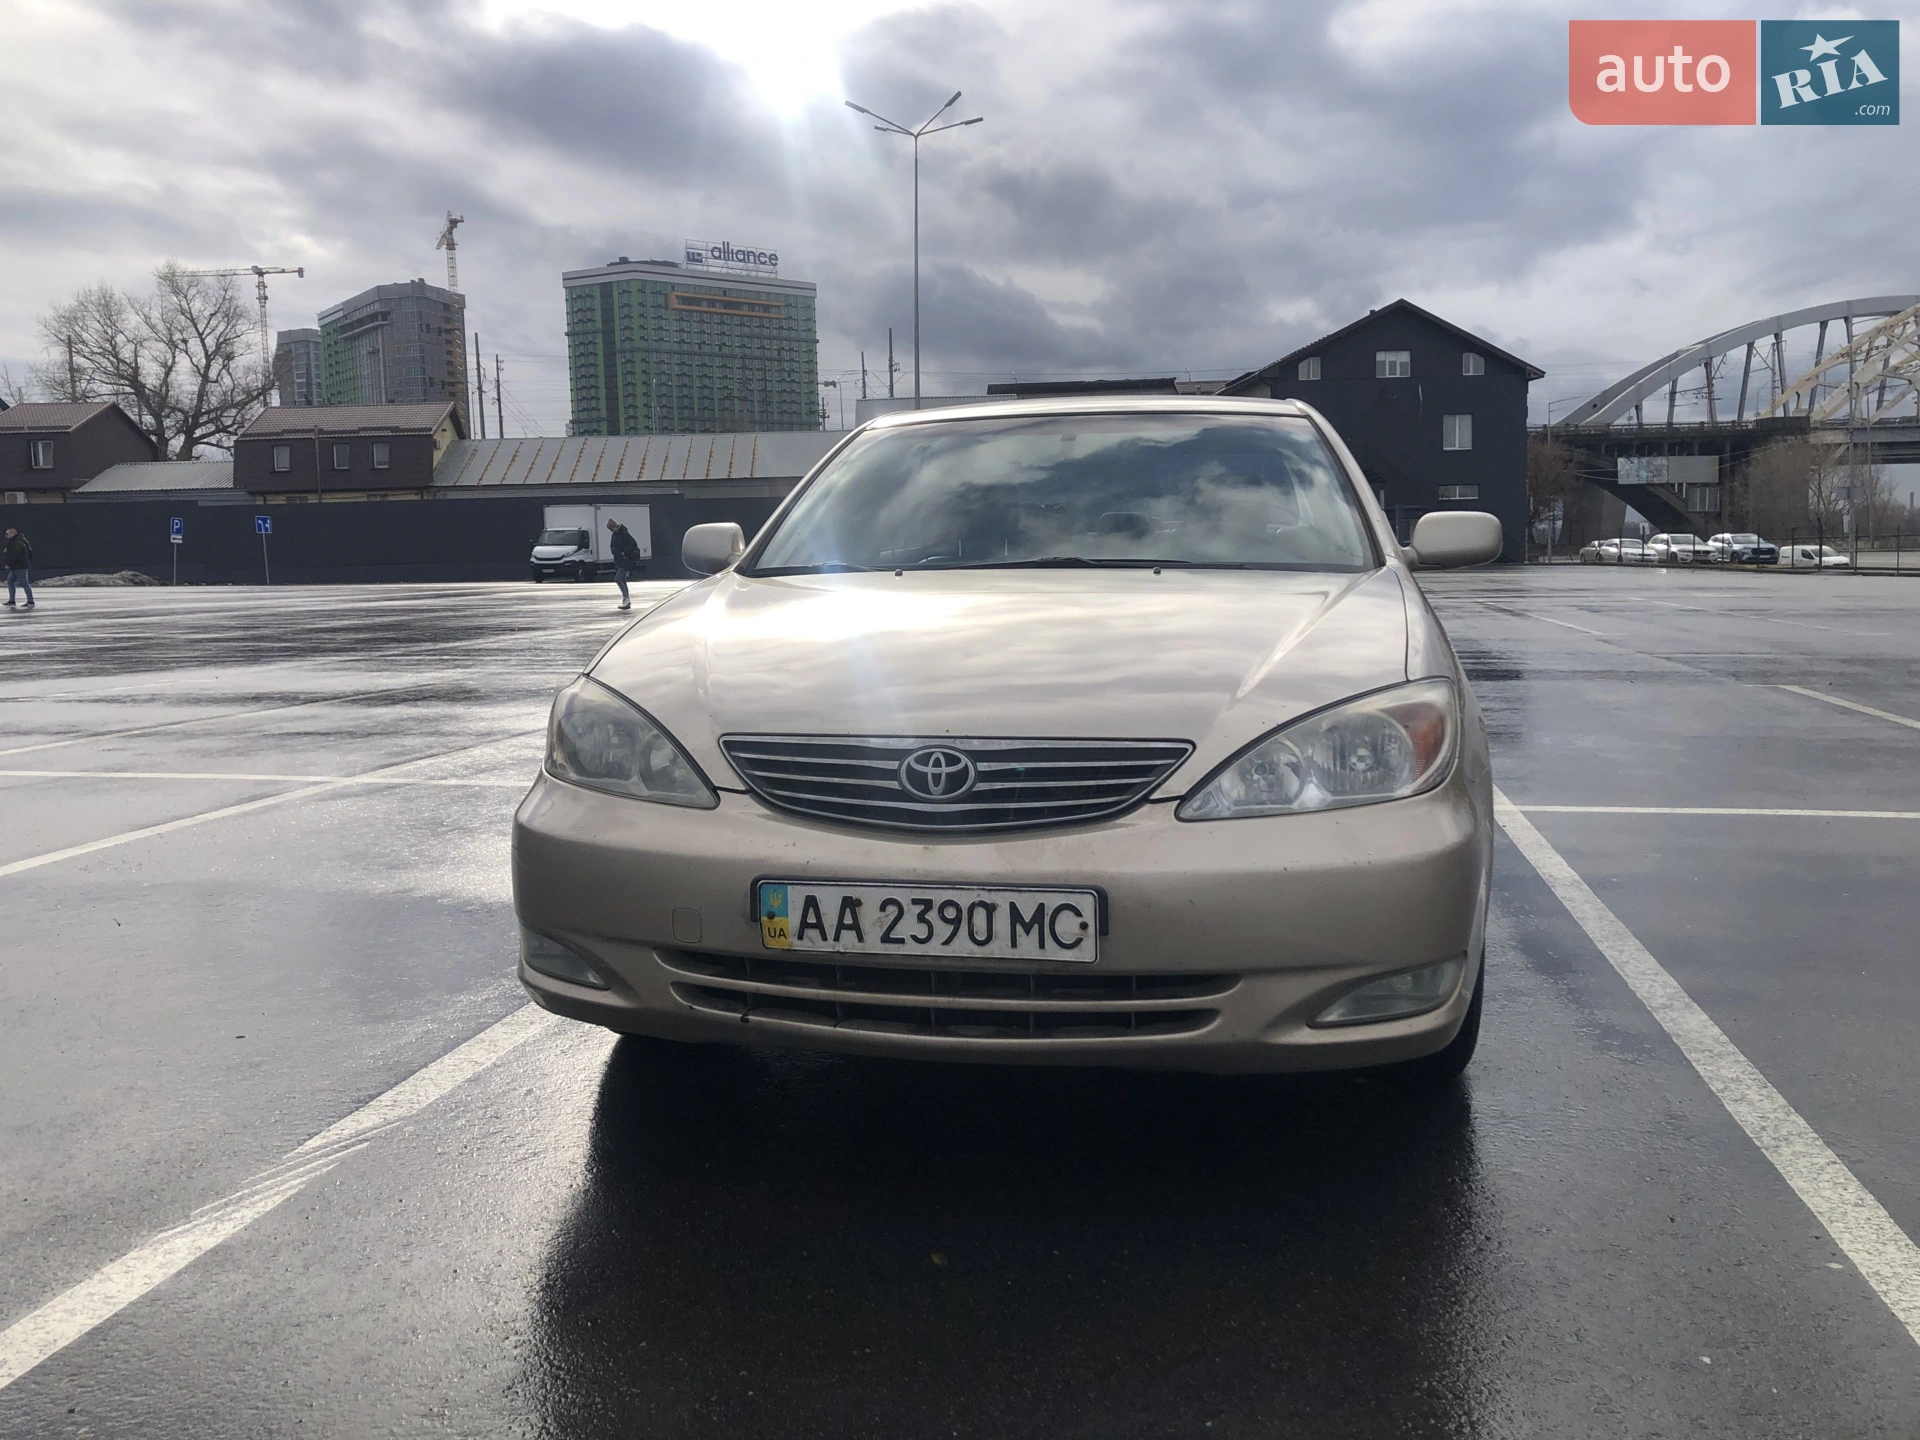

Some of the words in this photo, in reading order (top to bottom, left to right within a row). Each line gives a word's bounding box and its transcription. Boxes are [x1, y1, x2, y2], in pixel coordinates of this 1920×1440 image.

[710, 241, 779, 267] alliance
[173, 519, 181, 533] P
[796, 894, 865, 943] AA
[879, 897, 996, 947] 2390
[1008, 901, 1085, 950] MC
[767, 926, 788, 939] UA
